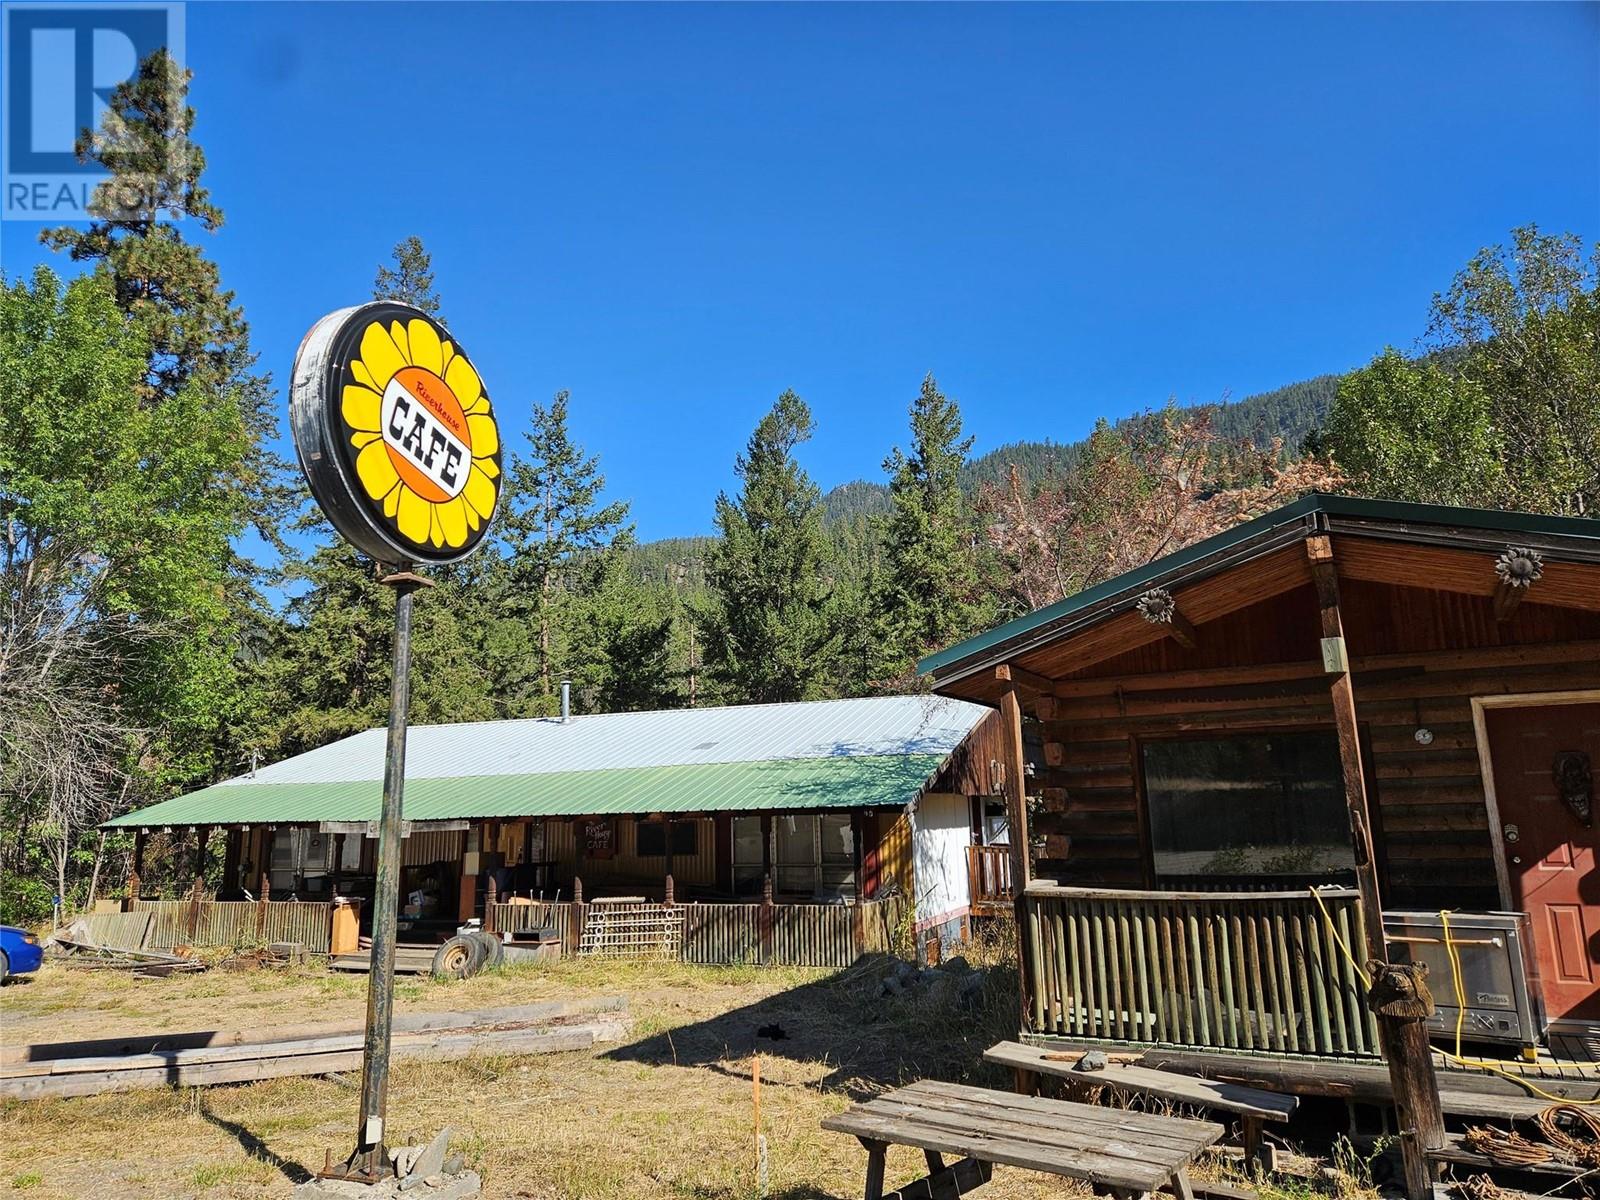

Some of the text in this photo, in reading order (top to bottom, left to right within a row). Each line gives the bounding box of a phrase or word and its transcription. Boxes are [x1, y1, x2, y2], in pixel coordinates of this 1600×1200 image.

[416, 381, 460, 432] Riverhouse
[389, 396, 462, 488] CAFE
[587, 840, 608, 848] CAFE
